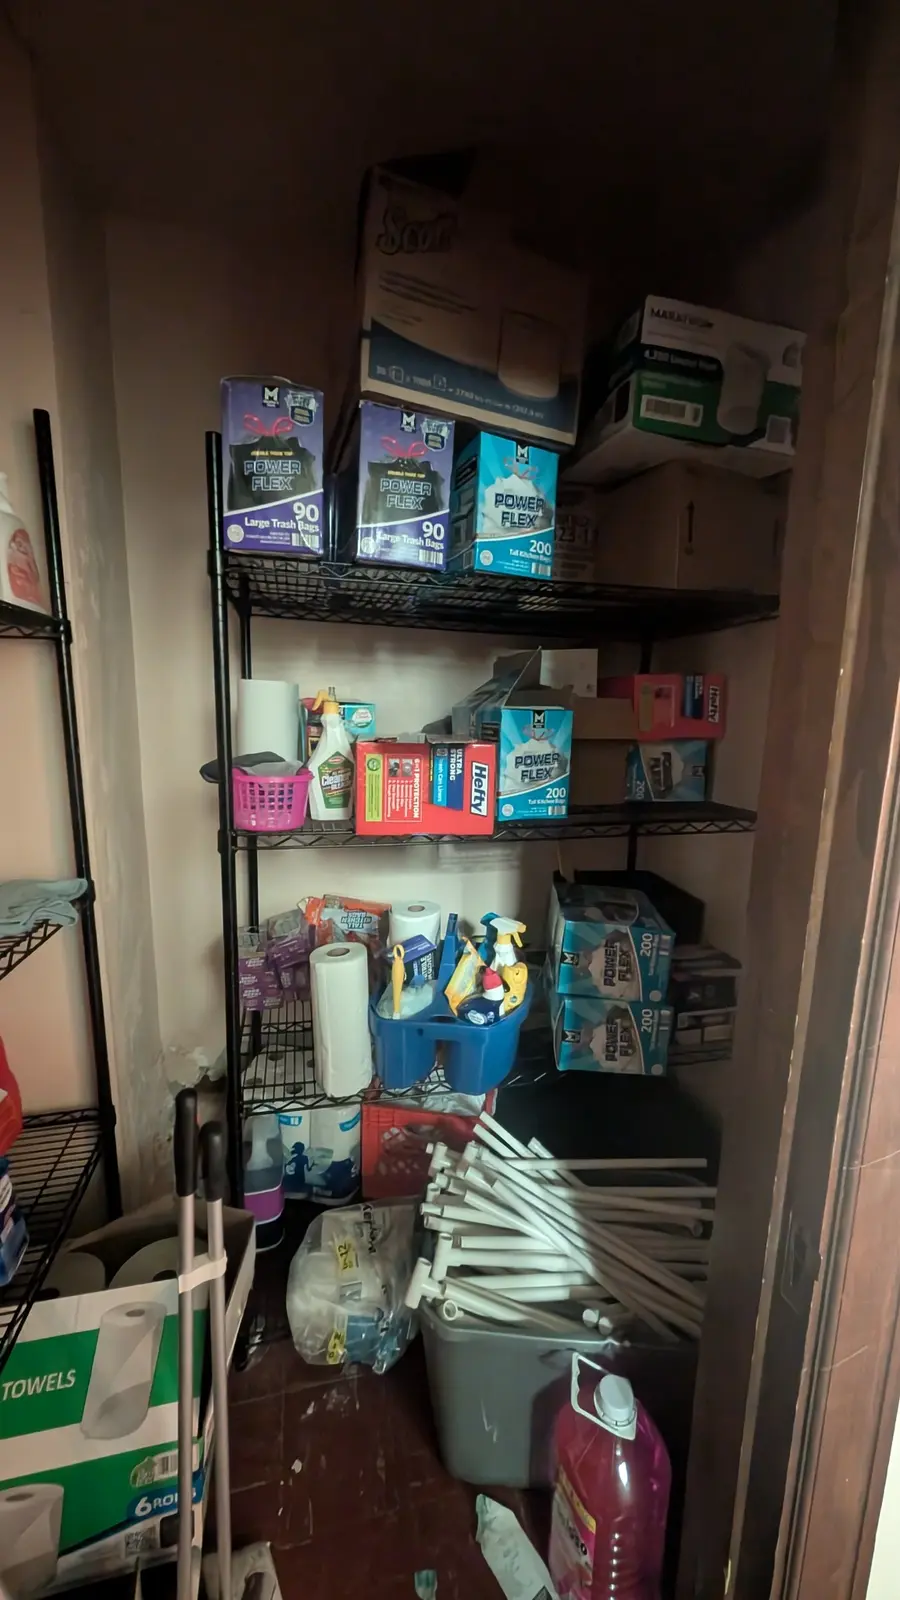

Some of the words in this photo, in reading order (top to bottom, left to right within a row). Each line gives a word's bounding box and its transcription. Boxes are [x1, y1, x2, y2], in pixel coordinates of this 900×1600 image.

[244, 460, 301, 475] POWER
[252, 476, 294, 491] FLEX
[380, 478, 432, 496] POWER
[387, 494, 425, 510] FLEX
[495, 493, 545, 513] POWER
[293, 502, 319, 522] 90
[501, 511, 538, 528] FLEX
[244, 516, 270, 529] Large
[271, 519, 296, 529] Trash
[298, 521, 319, 533] Bags
[422, 521, 445, 540] 90
[377, 531, 400, 544] Large
[401, 534, 424, 546] Trash
[425, 538, 444, 550] Bags
[529, 539, 552, 556] 200
[514, 753, 560, 769] POWER
[521, 767, 553, 782] FLEX
[472, 764, 486, 813] Hefty
[546, 787, 566, 798] 200
[640, 933, 653, 957] 200
[604, 940, 616, 987] POWER
[618, 951, 632, 981] FLEX
[640, 1008, 653, 1033] 200
[2, 1369, 76, 1401] TOWELS
[134, 1496, 152, 1517] 6
[153, 1487, 196, 1510] ROLS
